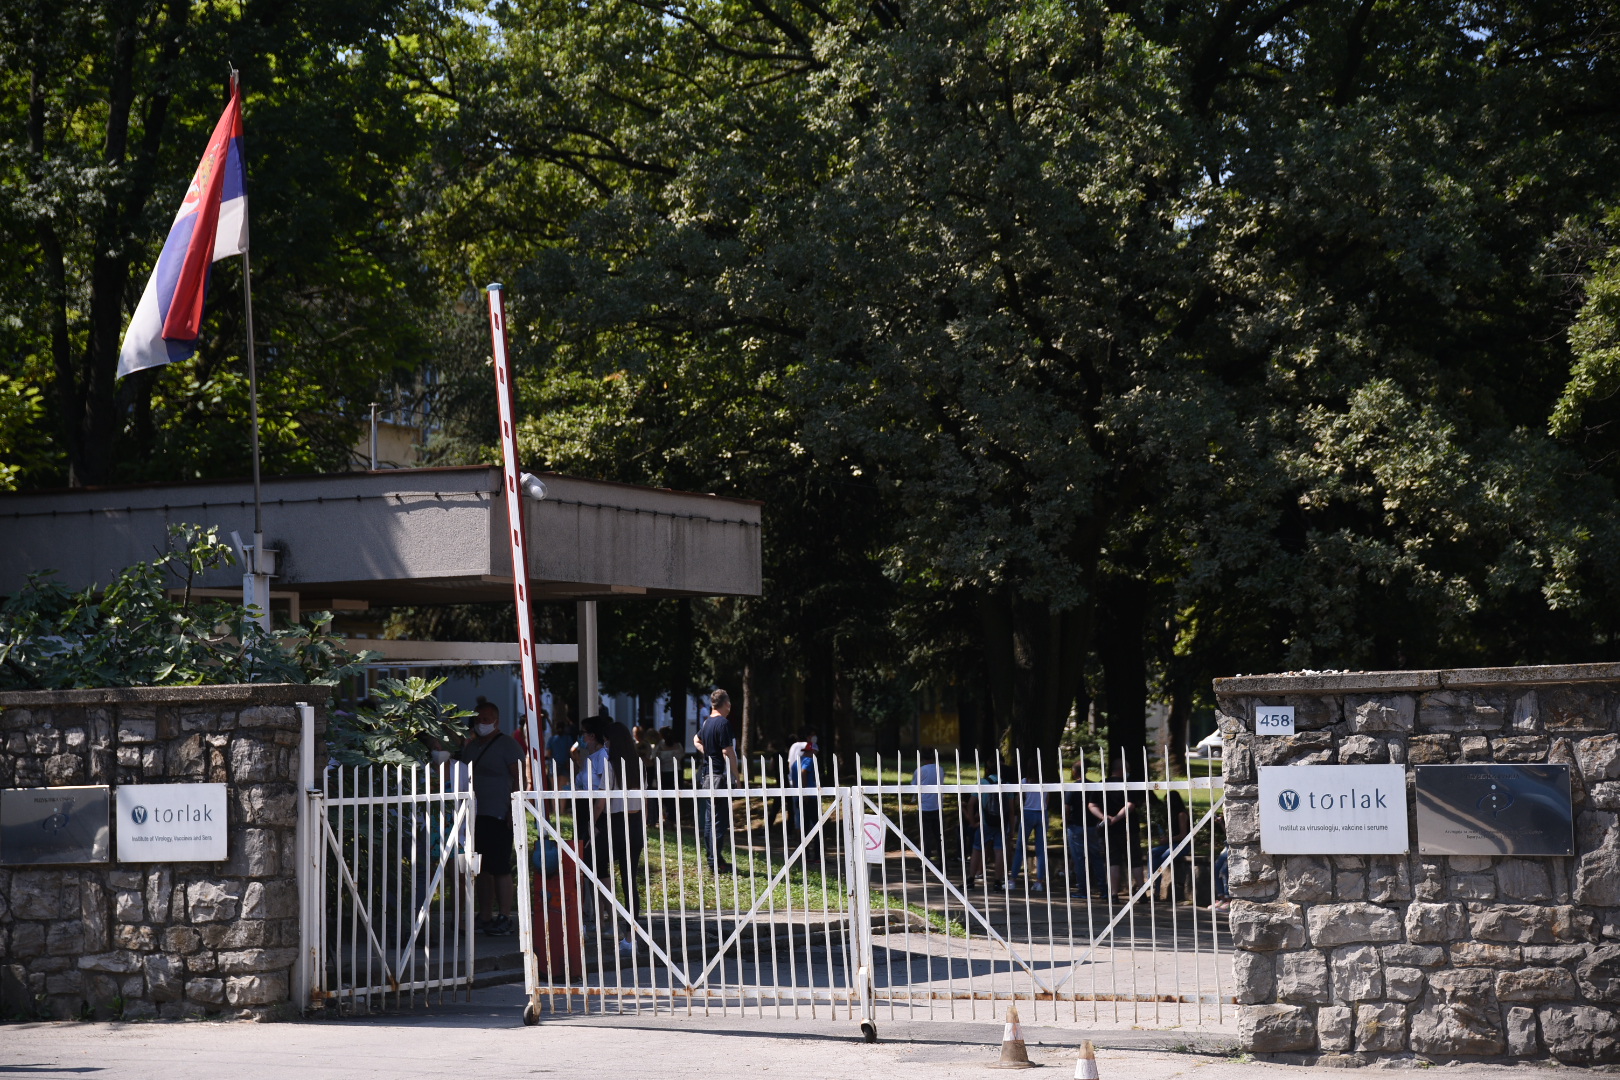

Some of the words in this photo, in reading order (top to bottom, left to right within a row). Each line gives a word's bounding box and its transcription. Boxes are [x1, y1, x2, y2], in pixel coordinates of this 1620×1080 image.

[1260, 714, 1290, 727] 458
[1308, 788, 1388, 810] torlak
[154, 804, 213, 823] torlak
